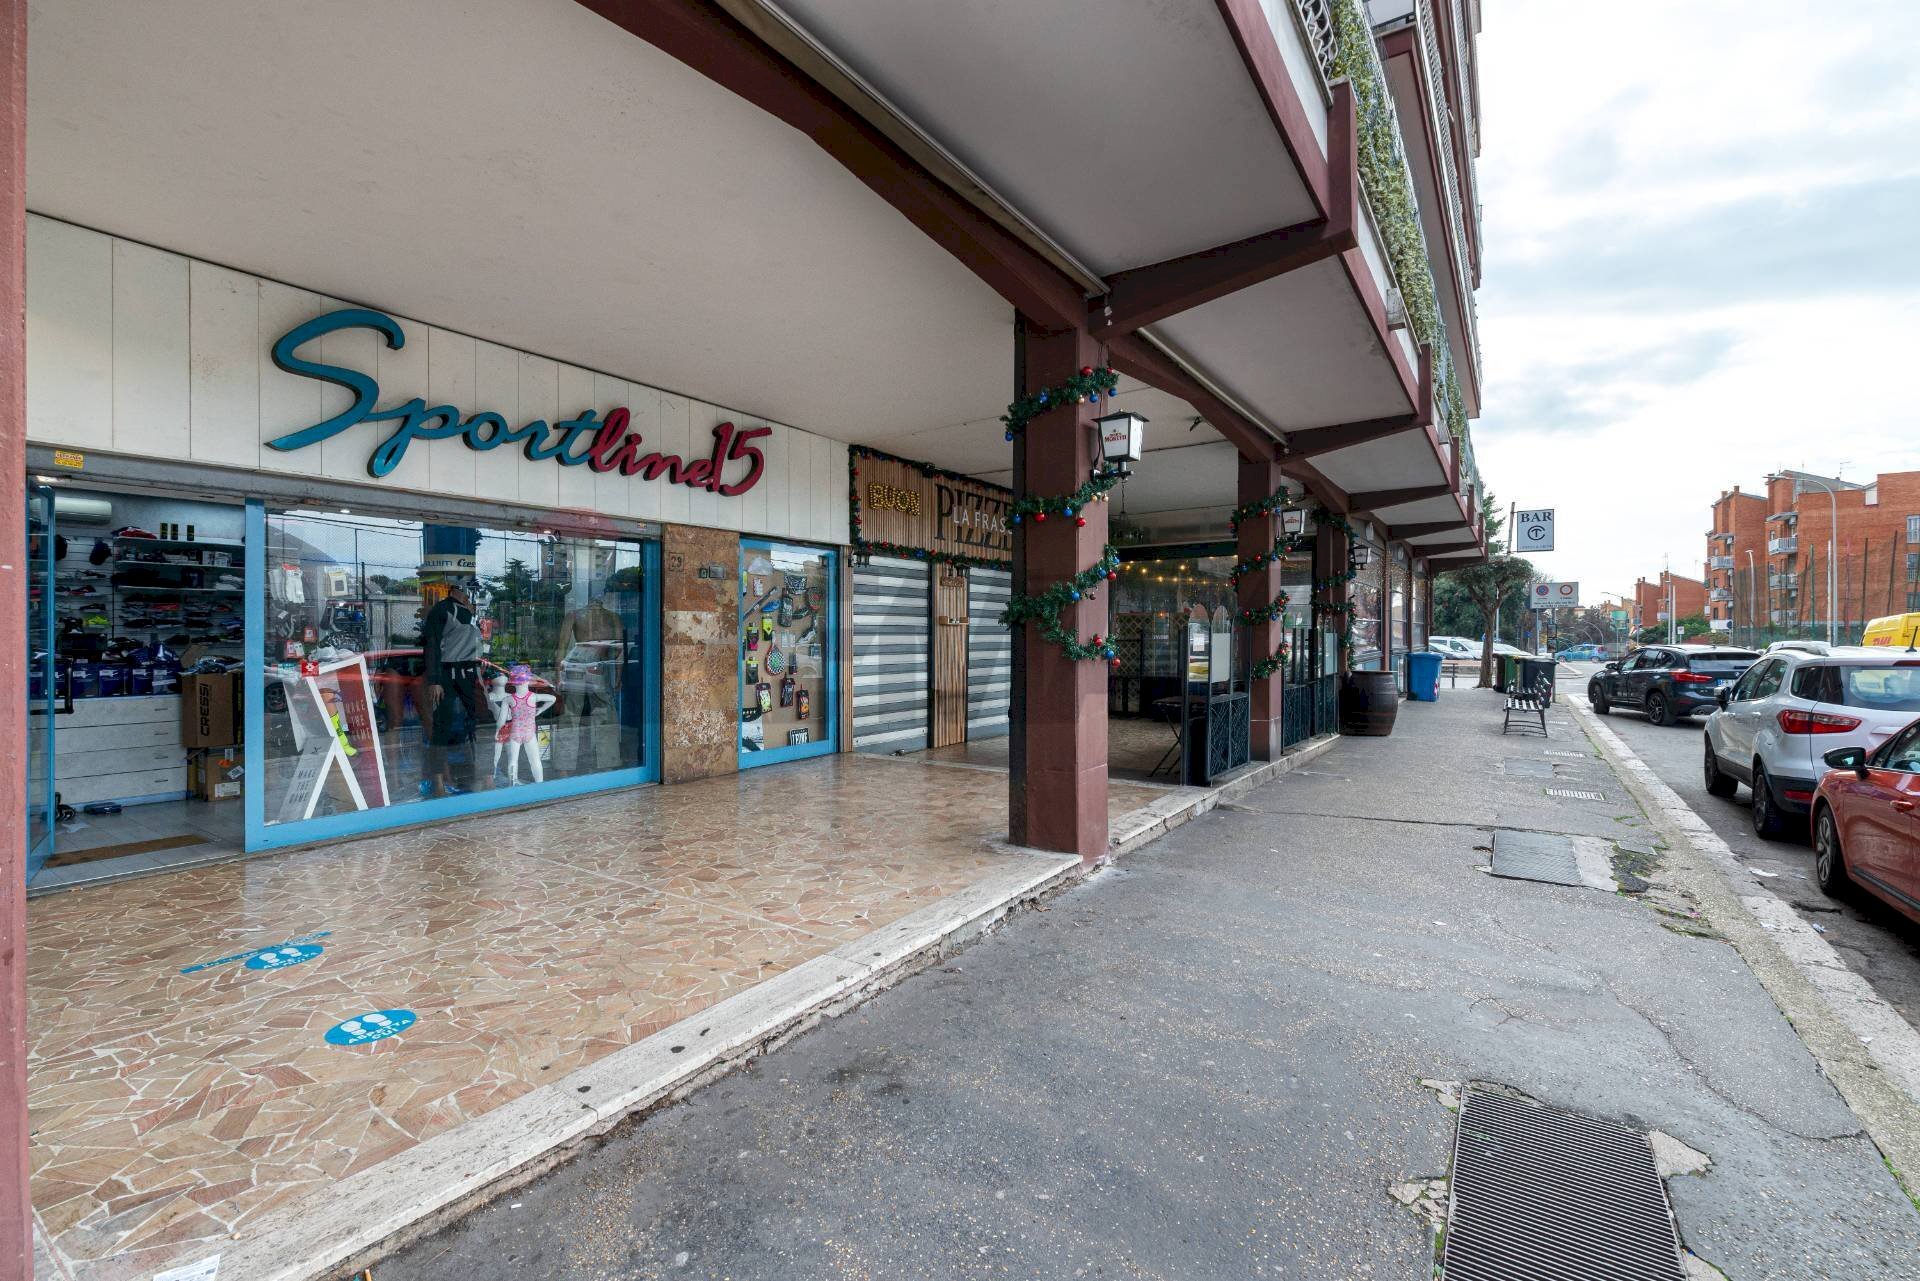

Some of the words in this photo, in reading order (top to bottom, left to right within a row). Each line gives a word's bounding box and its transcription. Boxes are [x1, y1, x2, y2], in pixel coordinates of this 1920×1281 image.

[869, 482, 921, 516] BUON
[953, 505, 970, 526] LA
[974, 511, 1013, 534] FRAS
[1520, 511, 1553, 523] BAR
[200, 683, 210, 737] CRESSI
